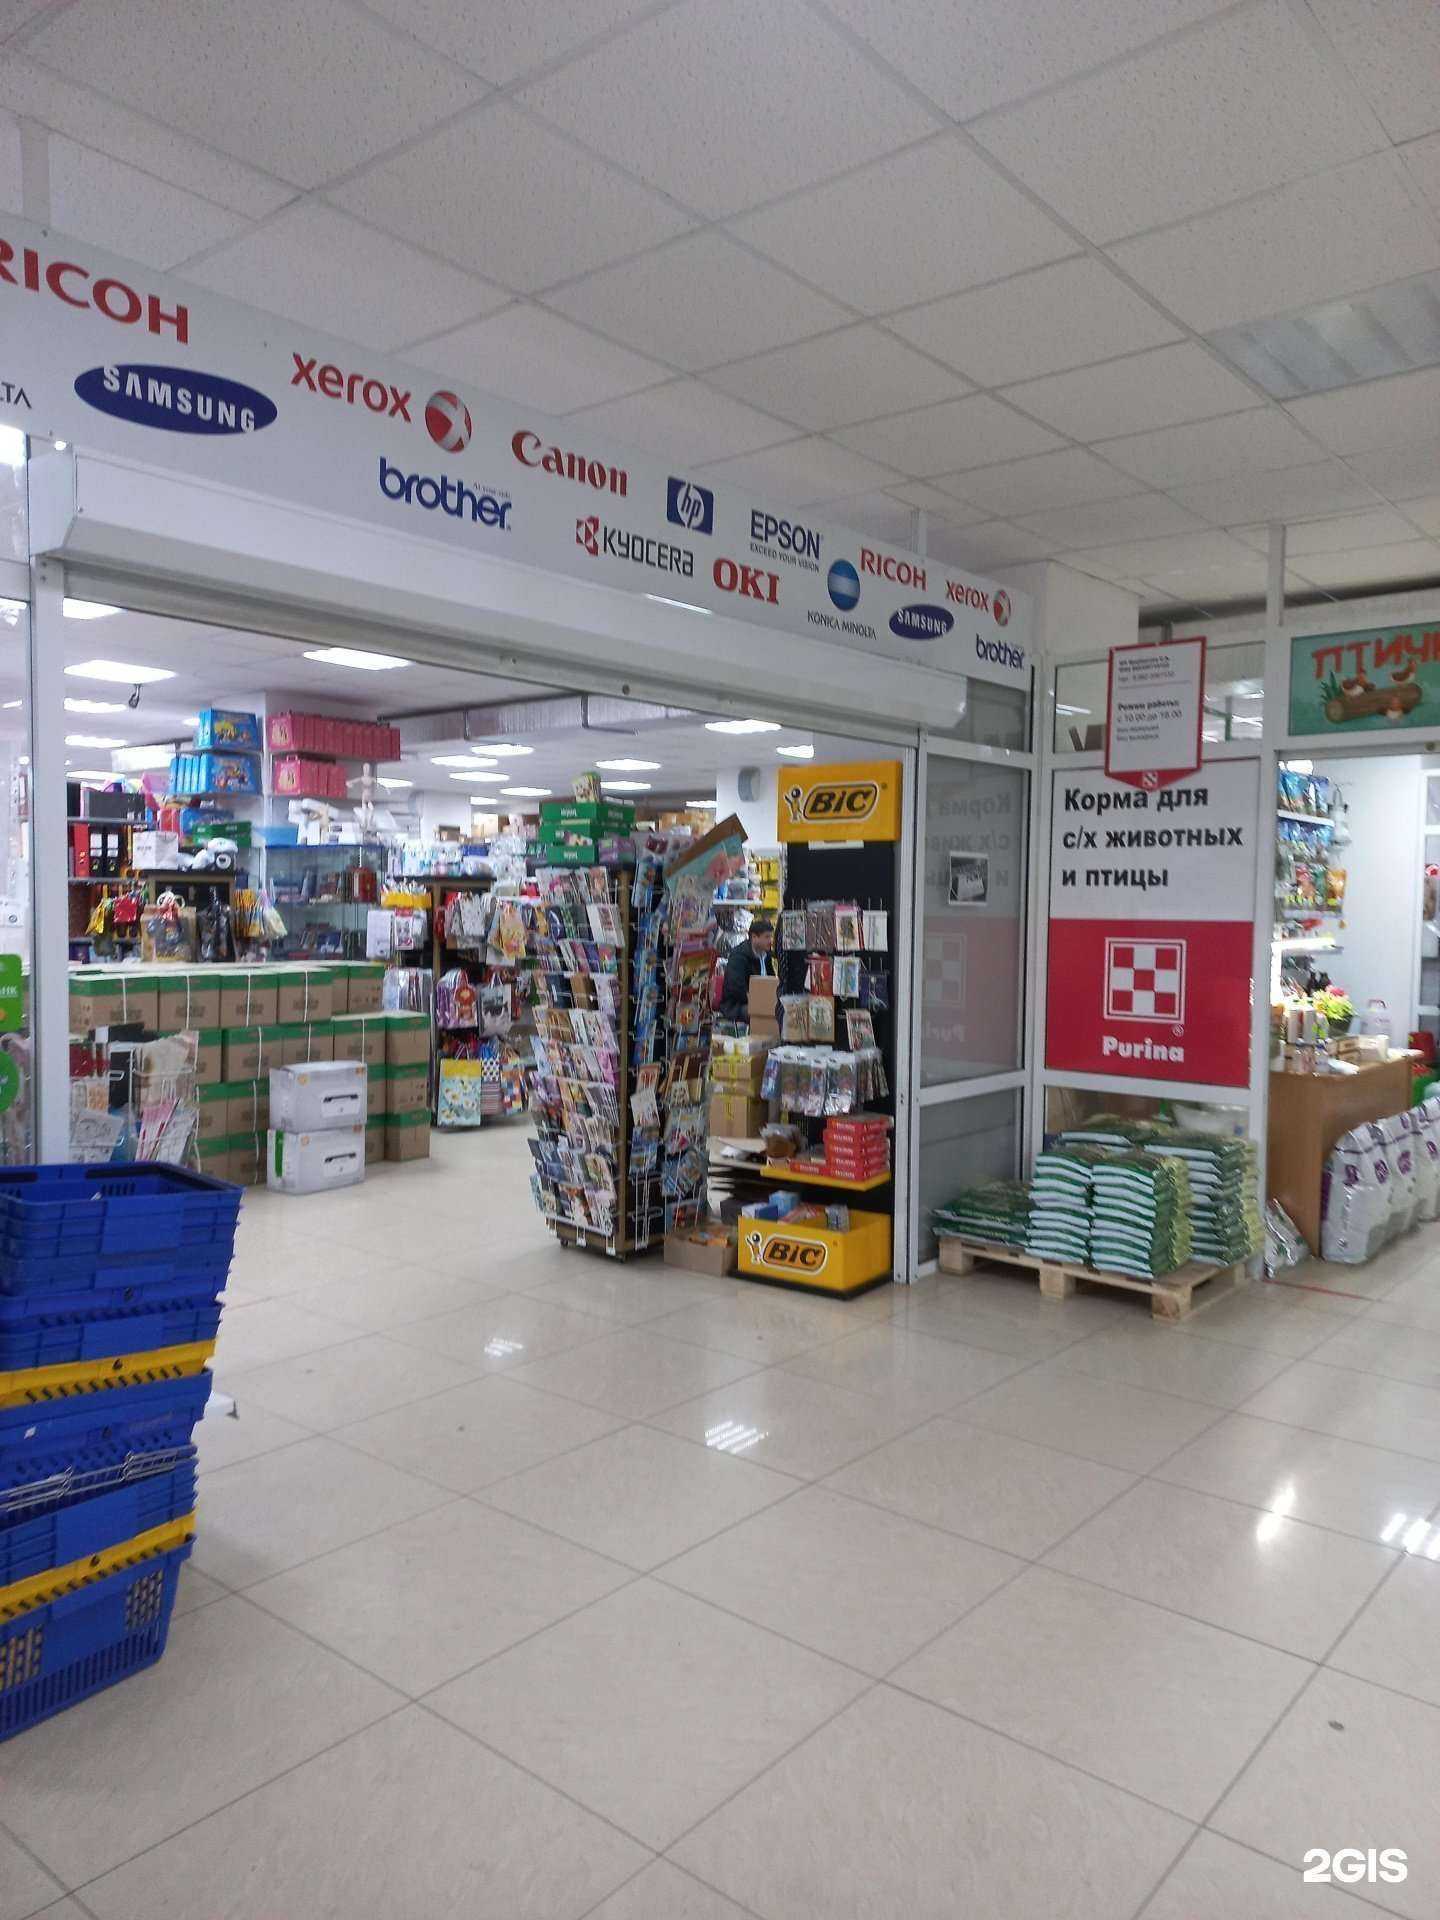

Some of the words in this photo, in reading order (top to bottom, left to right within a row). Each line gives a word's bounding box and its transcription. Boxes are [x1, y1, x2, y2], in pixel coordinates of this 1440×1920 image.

[0, 381, 32, 409] TA
[103, 365, 255, 433] SAMSUNG
[291, 352, 412, 424] xerox
[511, 430, 628, 497] Canon
[379, 456, 512, 530] brother
[750, 508, 820, 560] EPSON
[603, 525, 694, 578] KYOCERA
[750, 543, 777, 558] EXCEED
[778, 551, 796, 566] YOUR
[712, 557, 779, 605] OKI
[861, 548, 926, 591] RICOH
[945, 580, 989, 613] xerox
[807, 610, 839, 632] KONICA
[841, 621, 876, 640] MINOLTA
[897, 608, 948, 637] SAMSUNG
[976, 633, 1024, 670] brother
[808, 789, 873, 813] BIC
[1065, 788, 1148, 816] Корма
[1157, 788, 1208, 811] для
[1063, 825, 1097, 849] с/х
[1106, 827, 1244, 848] животных
[1062, 869, 1076, 886] и
[1086, 869, 1168, 891] птицы
[1102, 1035, 1184, 1062] Purina
[767, 1241, 822, 1265] BIC
